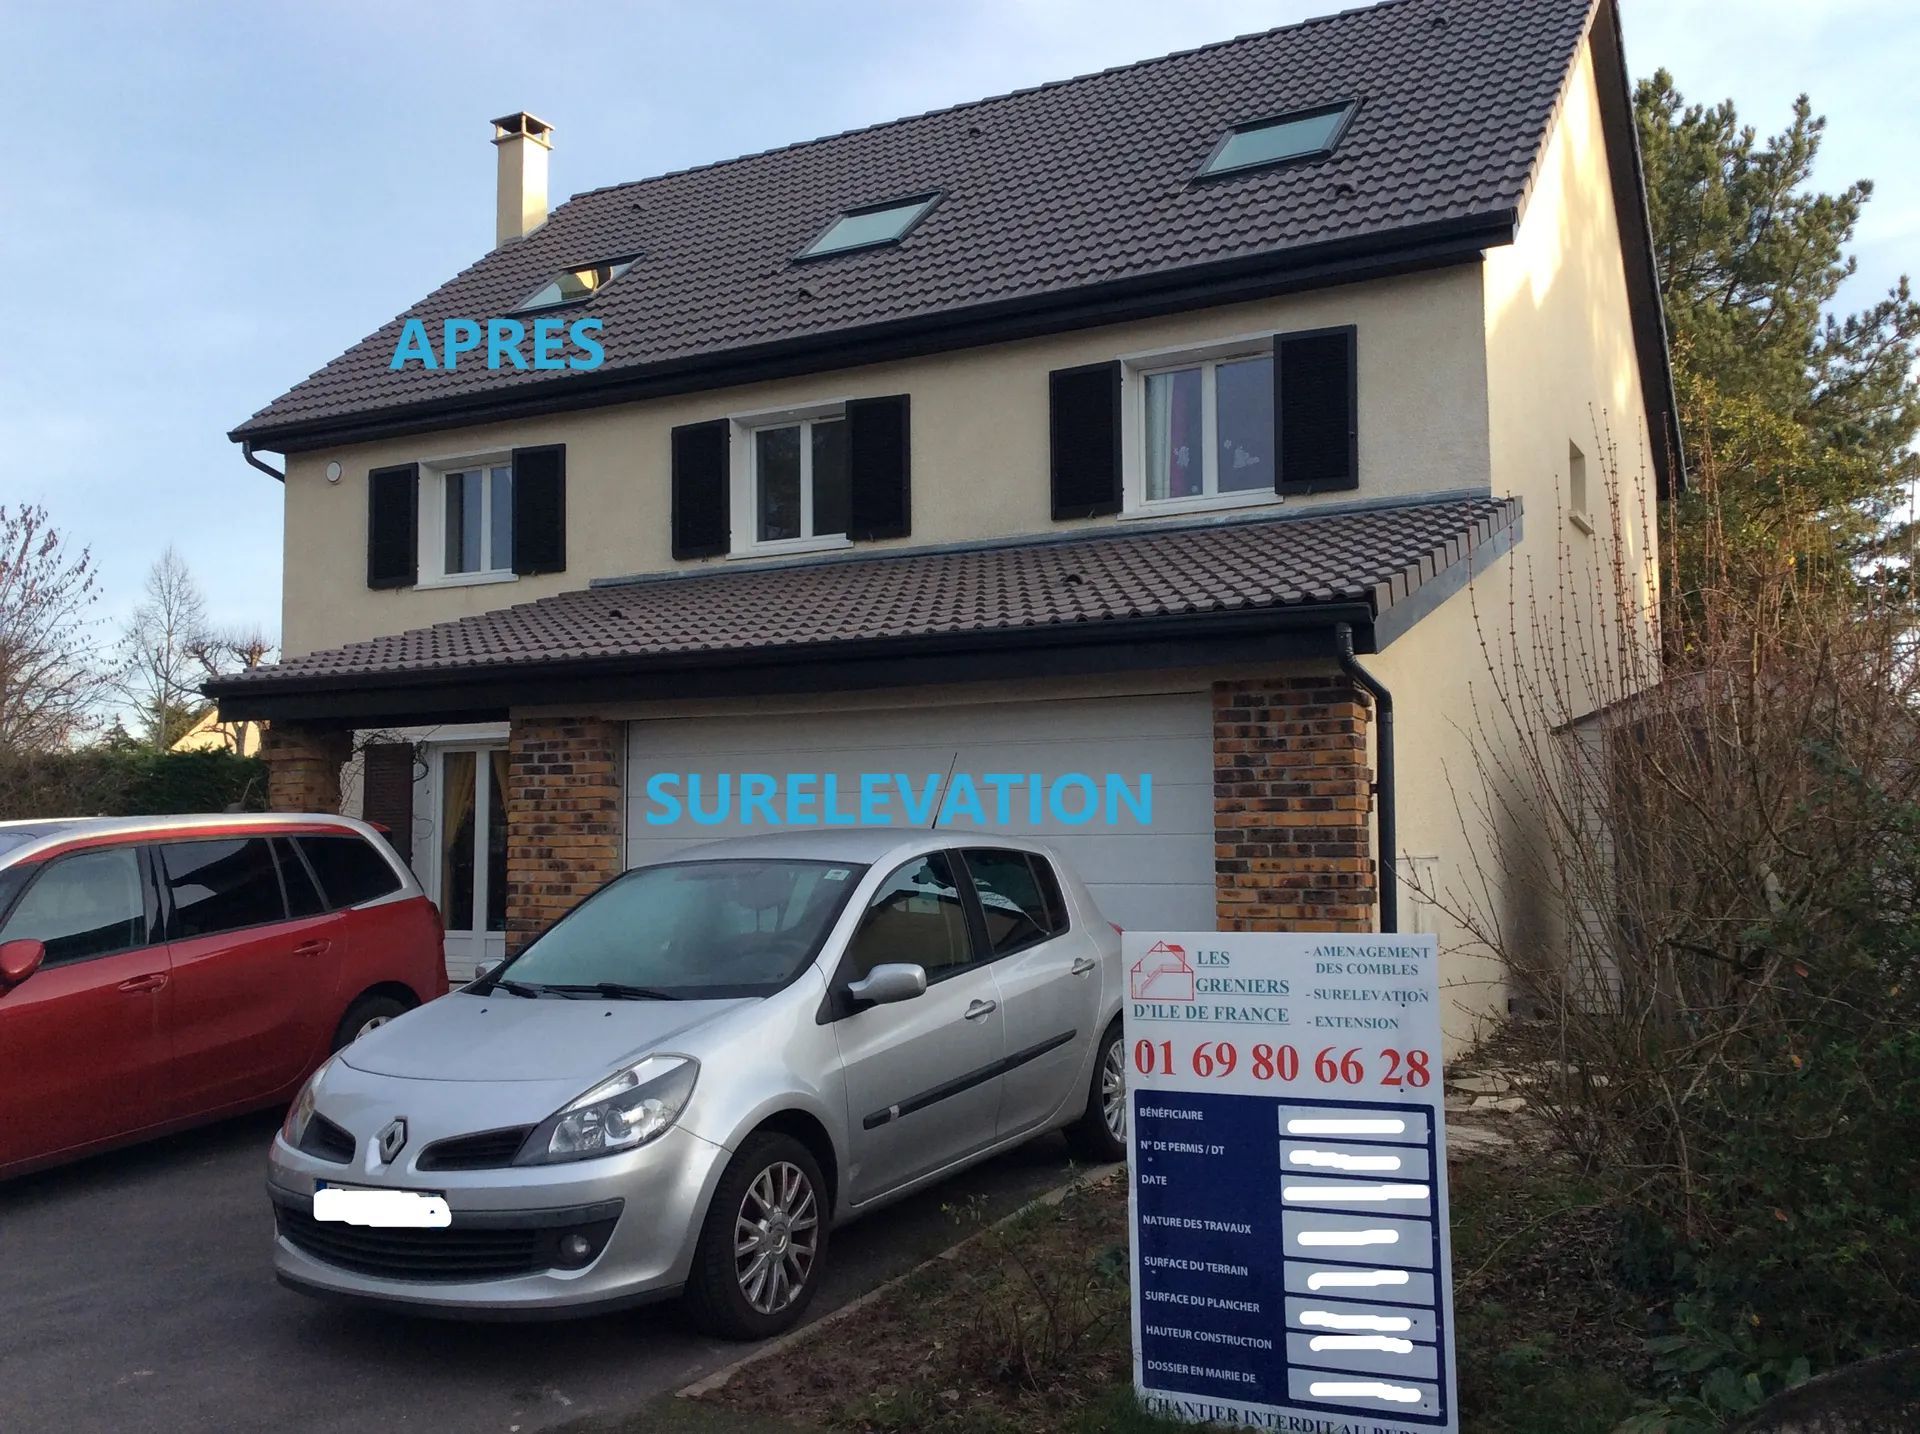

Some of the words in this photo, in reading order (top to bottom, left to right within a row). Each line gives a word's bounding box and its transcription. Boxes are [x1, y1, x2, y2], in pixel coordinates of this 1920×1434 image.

[1197, 951, 1230, 966] LES
[1313, 945, 1430, 959] AMENAGEMENT
[1316, 962, 1343, 974] DES
[1346, 963, 1419, 976] COMBLES
[1196, 977, 1290, 994] GRENIERS
[1314, 988, 1429, 1003] SURELEVATION
[1134, 1003, 1180, 1019] D'ILE
[1186, 1005, 1209, 1019] DE
[1215, 1006, 1289, 1022] FRANCE
[1315, 1015, 1399, 1030] EXTENSION
[1134, 1039, 1176, 1075] 01
[1192, 1041, 1237, 1077] 69
[1252, 1043, 1299, 1081] 80
[1314, 1046, 1364, 1084] 66
[1379, 1048, 1431, 1087] 28
[1139, 1106, 1204, 1120] BÉNÉFICIAIRE
[1140, 1140, 1151, 1150] N°
[1154, 1142, 1166, 1151] DE
[1168, 1143, 1204, 1154] PERMIS
[1211, 1146, 1224, 1155] DT
[1141, 1174, 1167, 1185] DATE
[1143, 1215, 1182, 1227] NATURE
[1184, 1219, 1202, 1229] DES
[1204, 1220, 1251, 1234] TRAVAUX
[1144, 1256, 1187, 1270] SURFACE
[1190, 1261, 1204, 1271] DU
[1205, 1262, 1248, 1276] TERRAIN
[1145, 1290, 1189, 1305] SURFACE
[1190, 1295, 1205, 1306] DU
[1207, 1297, 1260, 1313] PLANCHER
[1146, 1325, 1192, 1340] HAUTEUR
[1194, 1331, 1272, 1350] CONSTRUCTION
[1147, 1360, 1189, 1374] DOSSIER
[1190, 1366, 1204, 1376] EN
[1205, 1368, 1240, 1381] MAIRIE
[1242, 1373, 1256, 1383] DE
